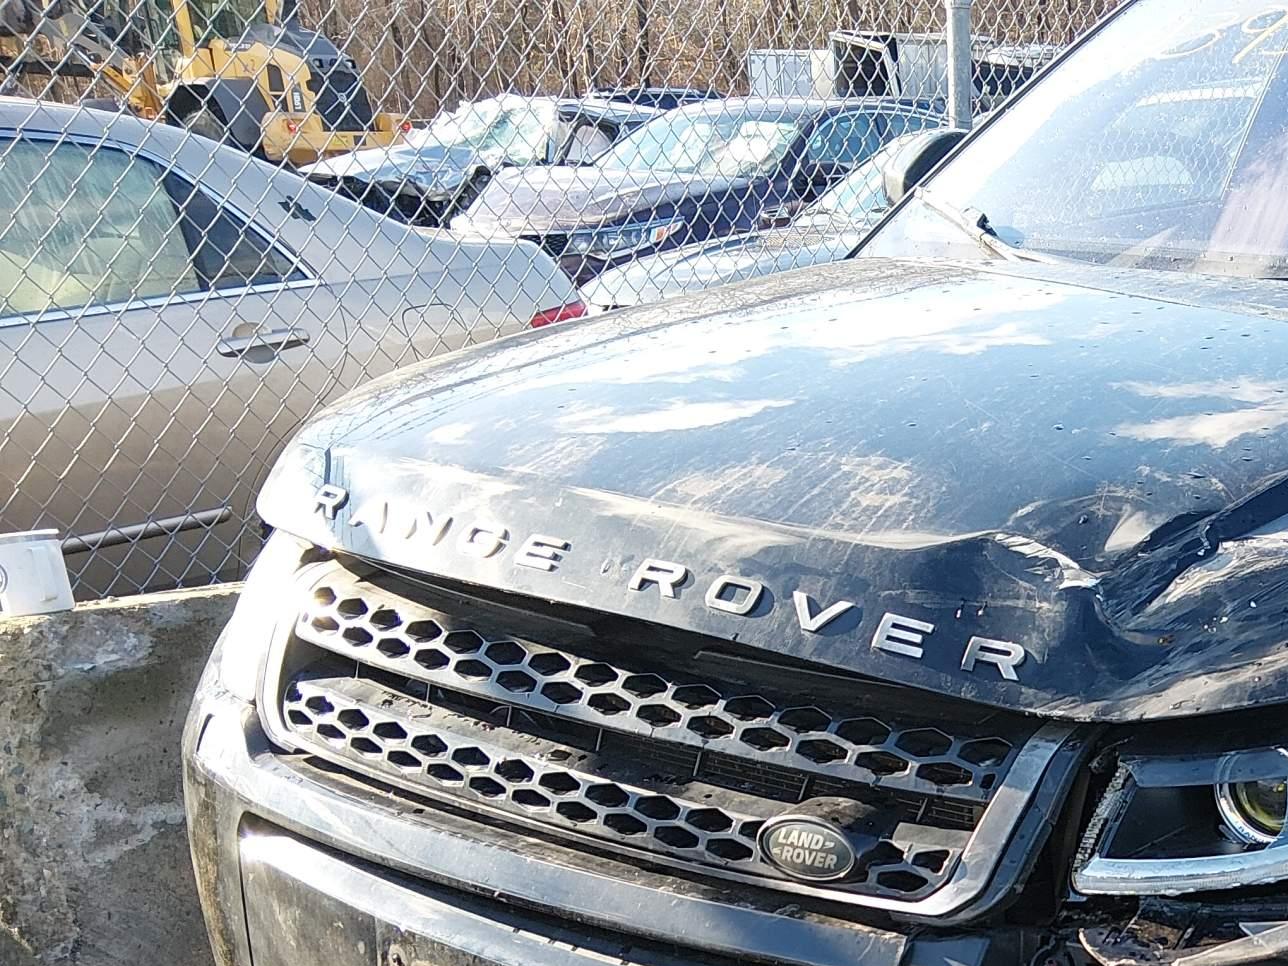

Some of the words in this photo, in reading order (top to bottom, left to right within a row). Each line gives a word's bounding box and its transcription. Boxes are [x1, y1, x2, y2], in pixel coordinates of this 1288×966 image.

[314, 484, 572, 572] RANGE
[629, 559, 1026, 681] ROVER
[778, 828, 824, 849] LAND
[781, 845, 838, 869] ROVER
